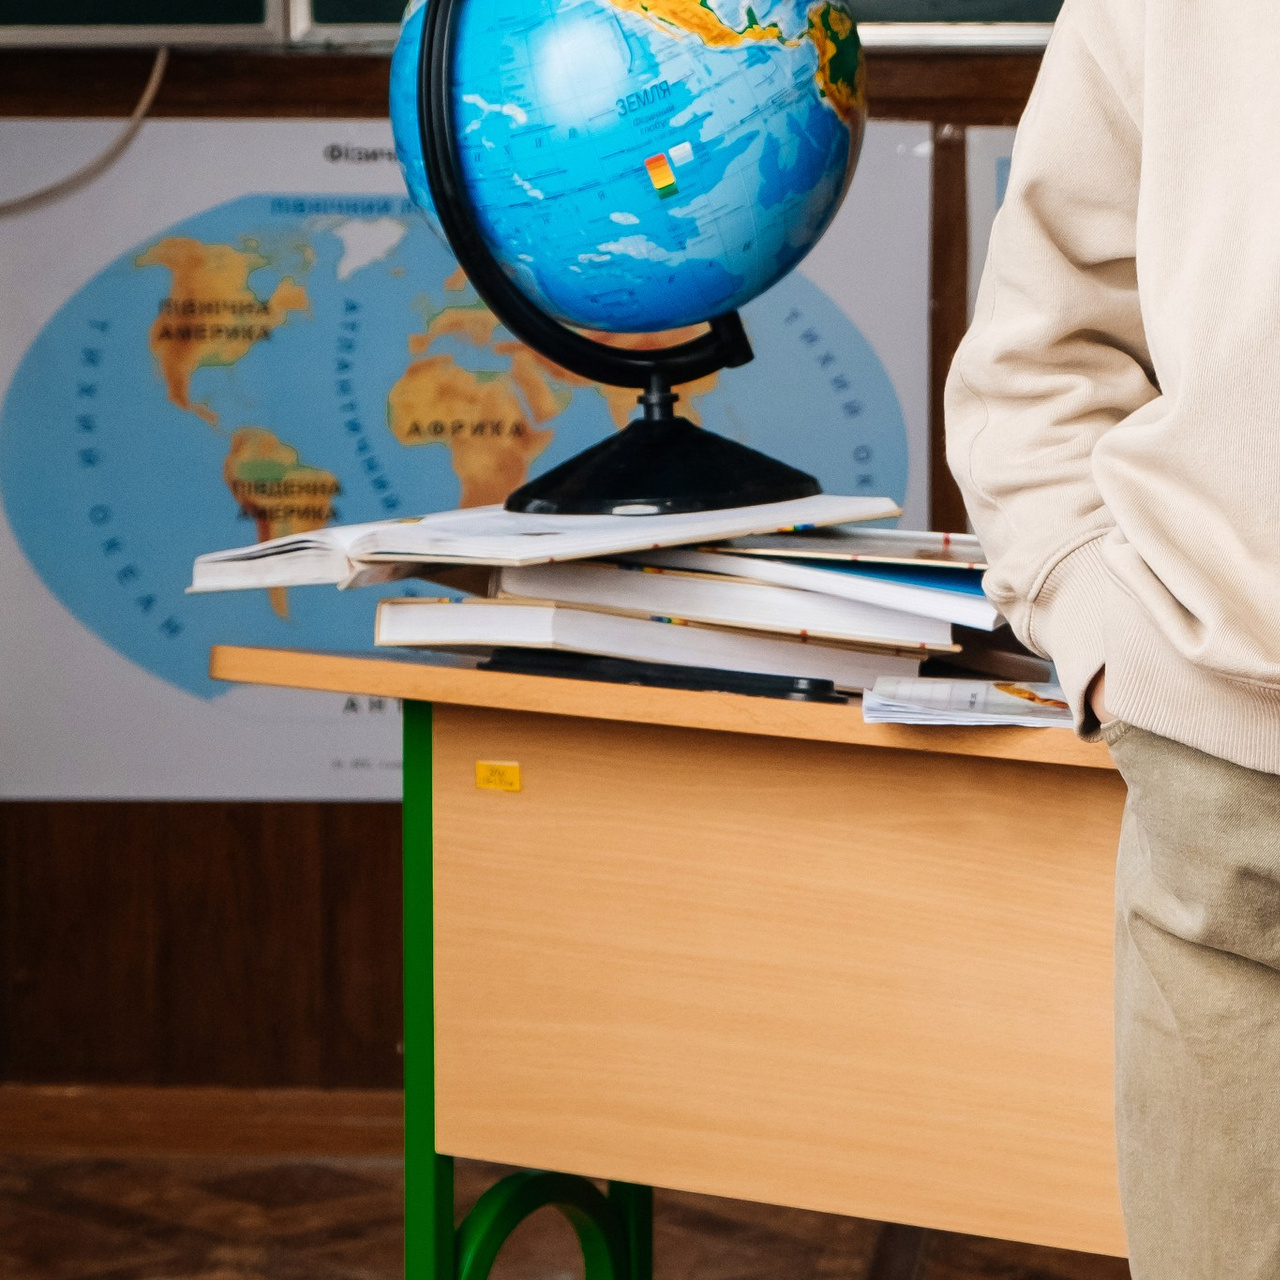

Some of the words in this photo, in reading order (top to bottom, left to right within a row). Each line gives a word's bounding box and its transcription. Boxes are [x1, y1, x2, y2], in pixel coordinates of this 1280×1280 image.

[615, 79, 671, 117] ЗЕМЛЯ
[325, 144, 398, 163] Фізич
[405, 417, 525, 438] АФРИКА
